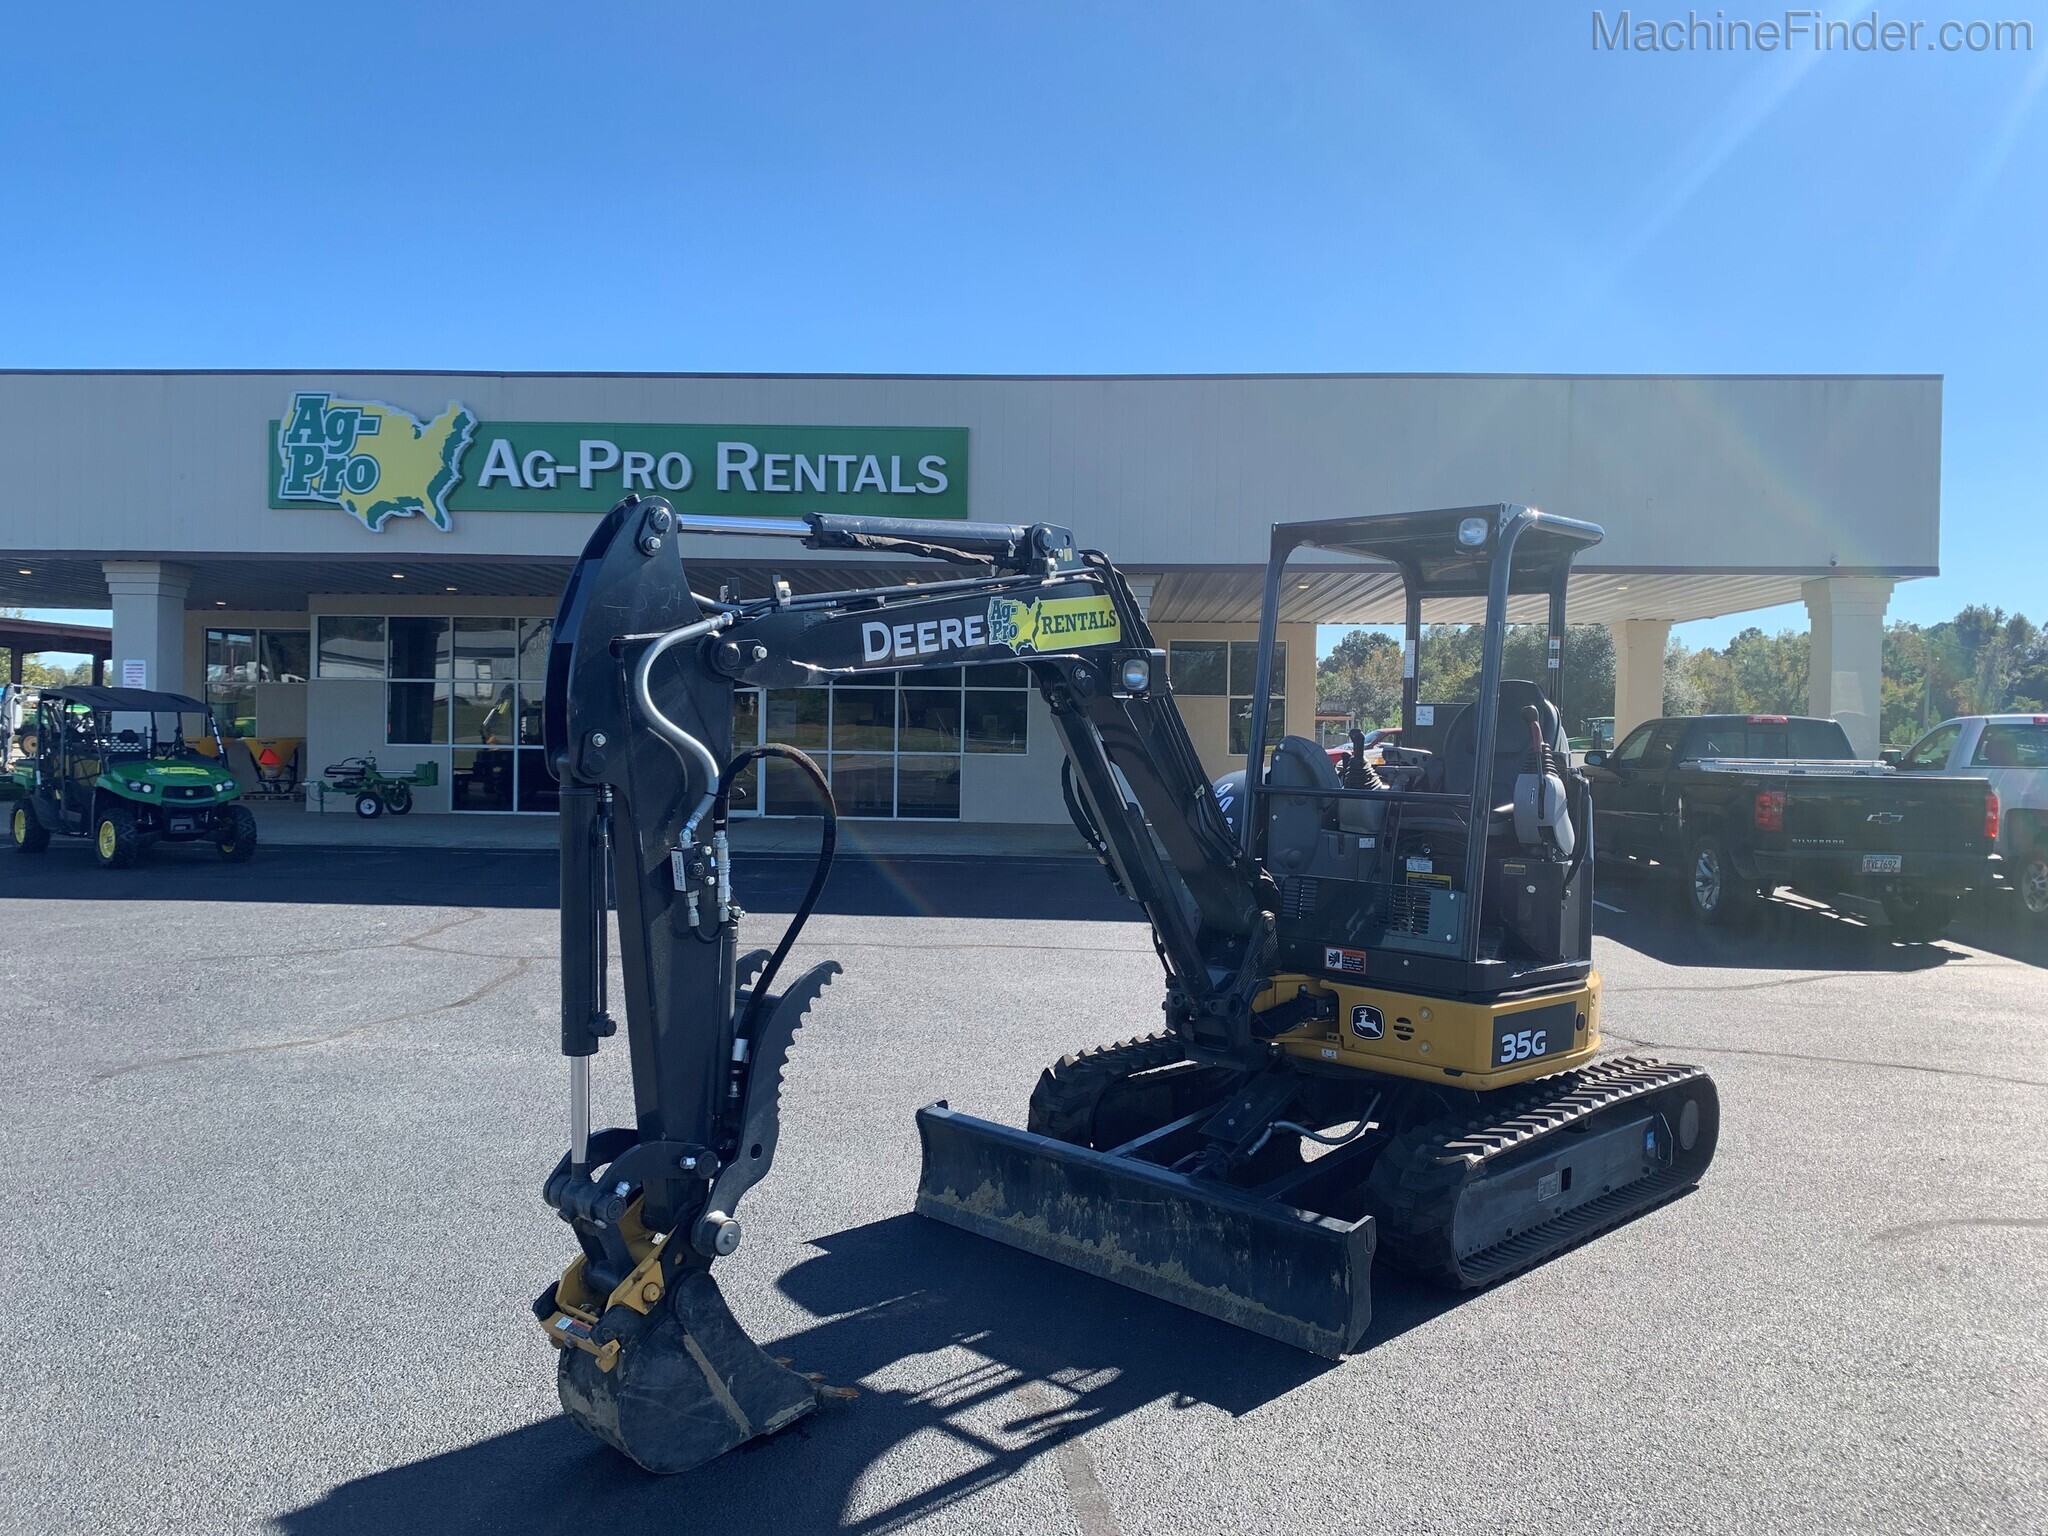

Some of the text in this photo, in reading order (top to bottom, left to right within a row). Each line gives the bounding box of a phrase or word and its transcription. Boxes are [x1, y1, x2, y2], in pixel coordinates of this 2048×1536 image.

[285, 393, 382, 458] Ag-
[282, 443, 381, 496] Pro
[716, 441, 949, 495] RENTALS
[991, 598, 1018, 623] Ag-
[991, 619, 1020, 642] Pro
[1041, 609, 1118, 636] RENTALS
[861, 614, 986, 663] DEERE
[1500, 1029, 1547, 1063] 35G
